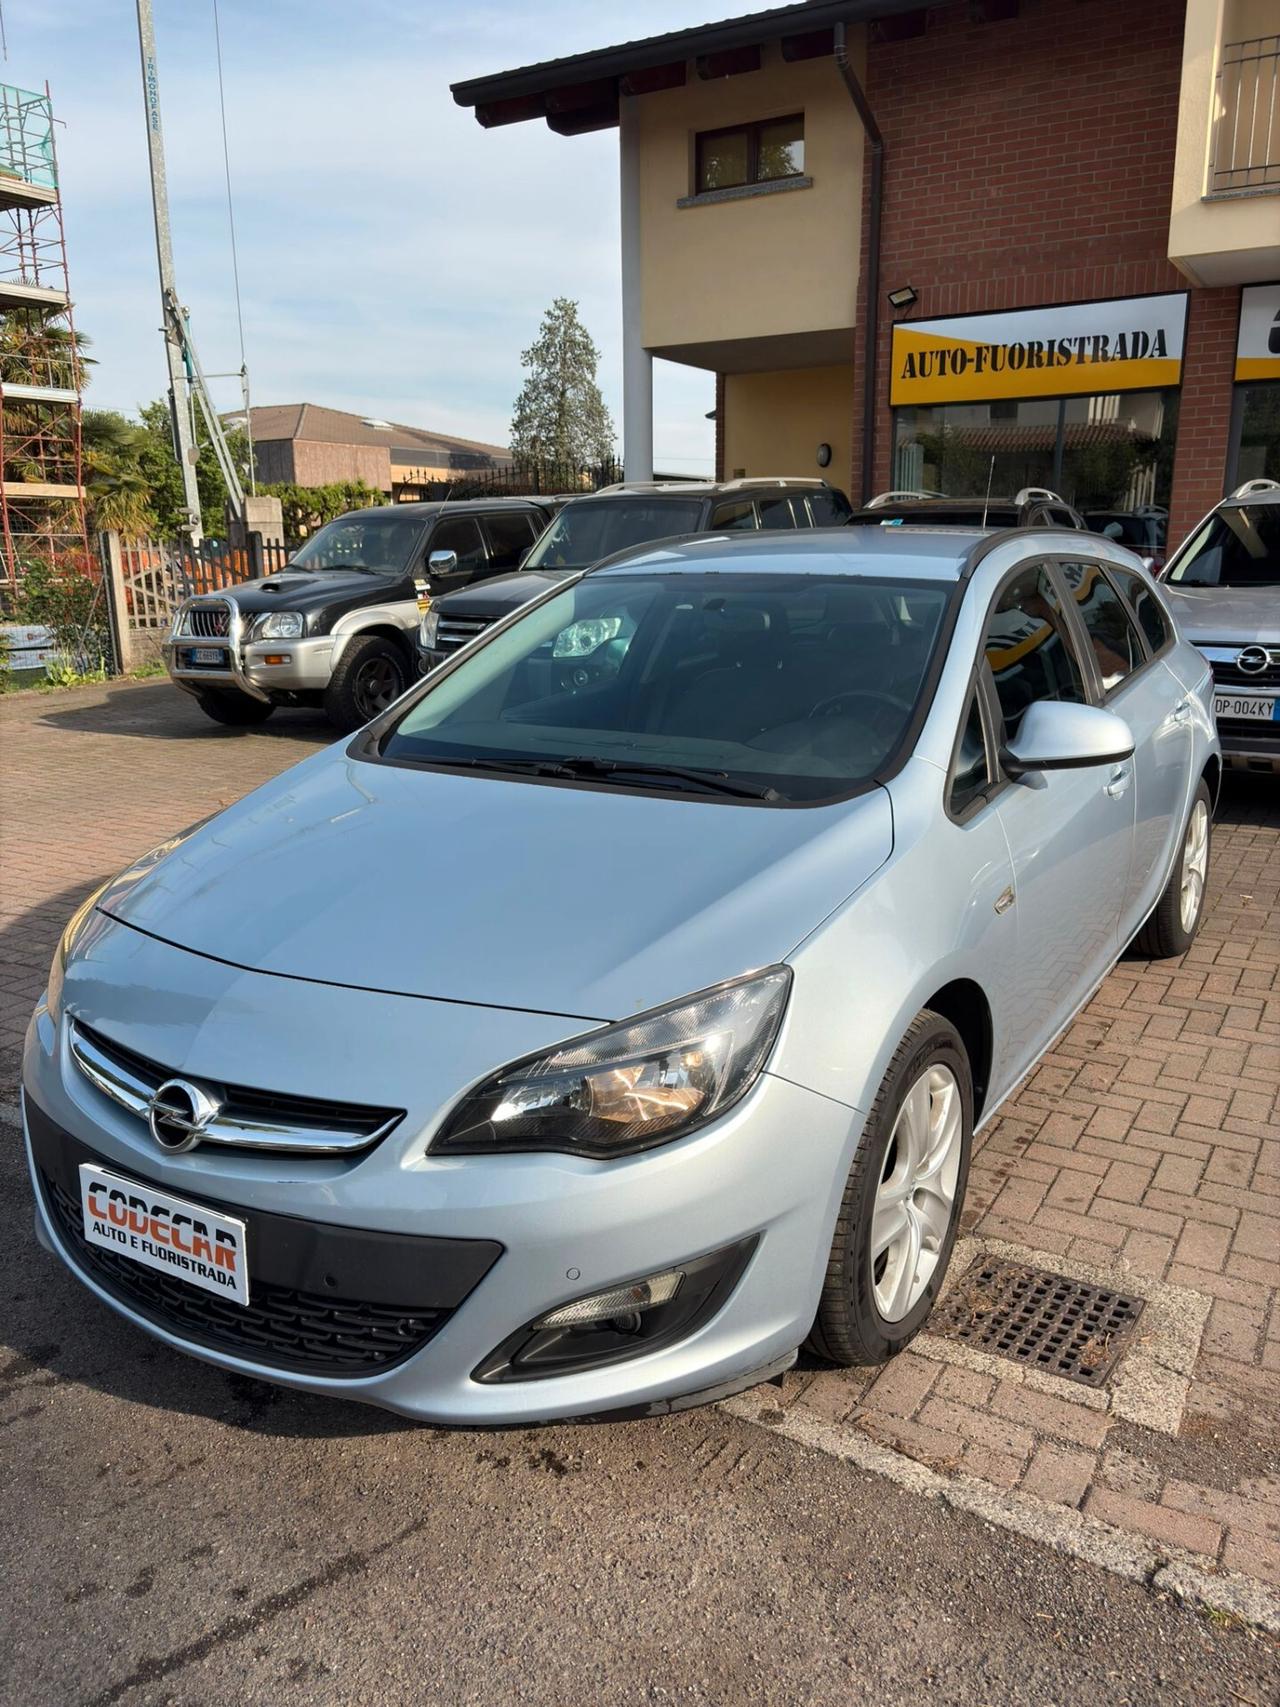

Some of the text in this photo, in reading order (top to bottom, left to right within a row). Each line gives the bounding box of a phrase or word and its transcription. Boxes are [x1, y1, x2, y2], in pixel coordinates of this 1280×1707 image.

[901, 328, 1168, 379] AUTO-FUORISTRADA
[88, 1181, 237, 1272] CODECAR
[93, 1220, 237, 1290] AUTO E FUORISTRADA
